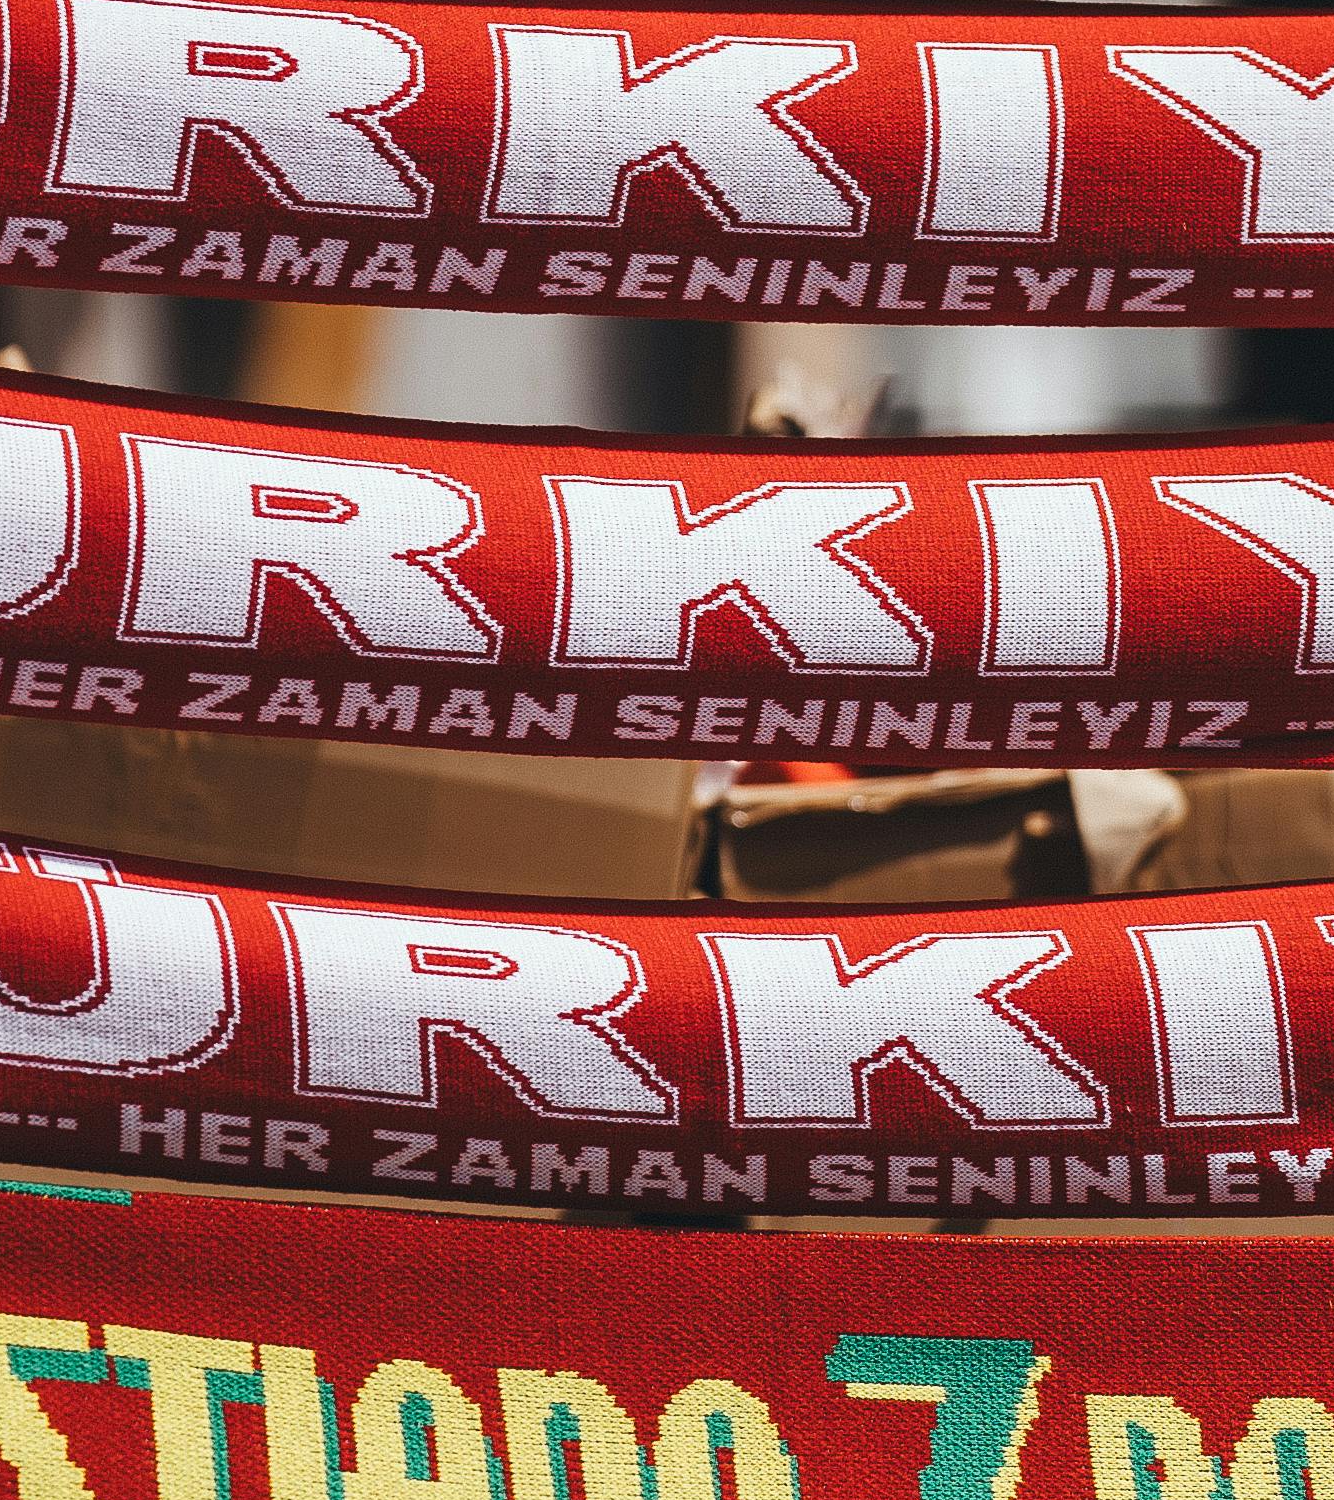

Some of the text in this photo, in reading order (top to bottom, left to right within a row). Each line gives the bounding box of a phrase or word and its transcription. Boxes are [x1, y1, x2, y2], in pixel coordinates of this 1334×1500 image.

[98, 222, 507, 297] ZAMAN
[539, 249, 1197, 314] SENINLEYIZ
[179, 671, 580, 741] ZAMAN
[613, 693, 1252, 752] SENINLEYIZ
[119, 1104, 329, 1174] HER
[372, 1128, 769, 1201] ZAMAN
